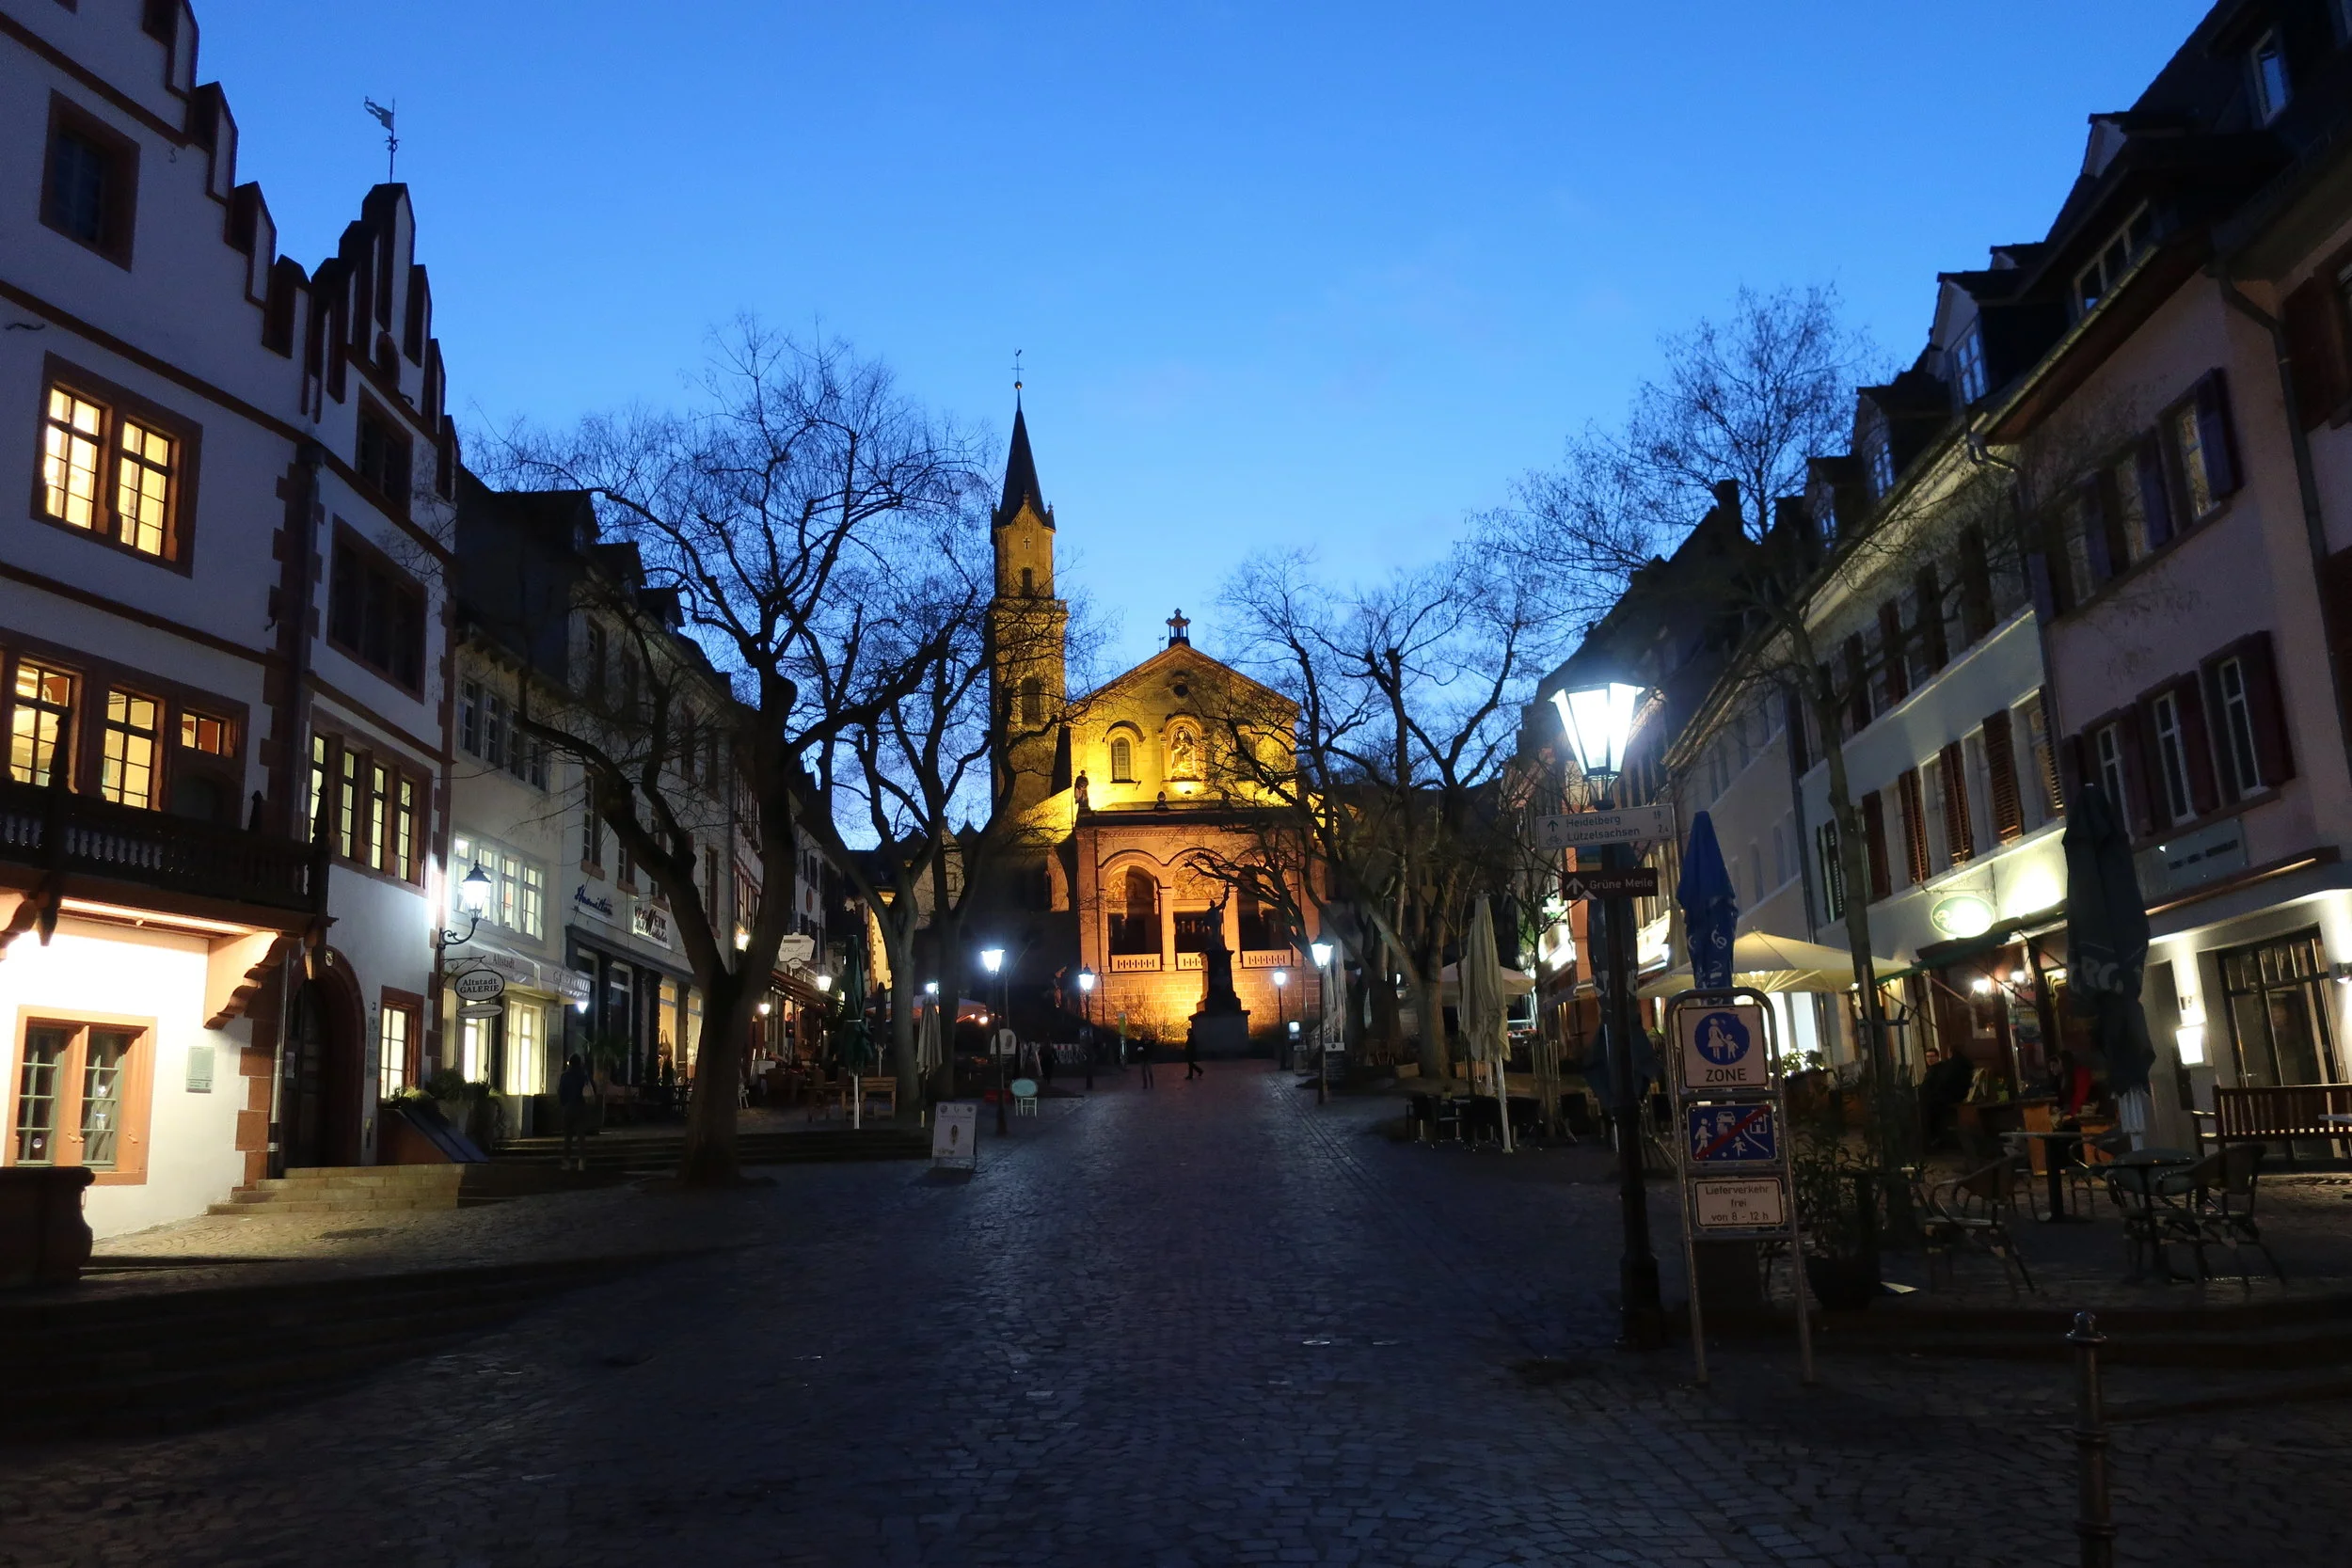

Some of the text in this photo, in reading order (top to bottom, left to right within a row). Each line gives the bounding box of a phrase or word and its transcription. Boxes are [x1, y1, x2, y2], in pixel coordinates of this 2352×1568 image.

[1566, 816, 1621, 828] Heidelberg
[1567, 828, 1640, 842] Lützelsachsen
[1589, 877, 1654, 890] Grüne Meile
[460, 985, 500, 993] GALERIE
[1706, 1068, 1747, 1082] ZONE
[1706, 1186, 1769, 1195] Lieferverkehr
[1731, 1198, 1747, 1207] frei
[1732, 1212, 1738, 1221] 8
[1750, 1211, 1759, 1220] 12
[1762, 1212, 1769, 1220] h
